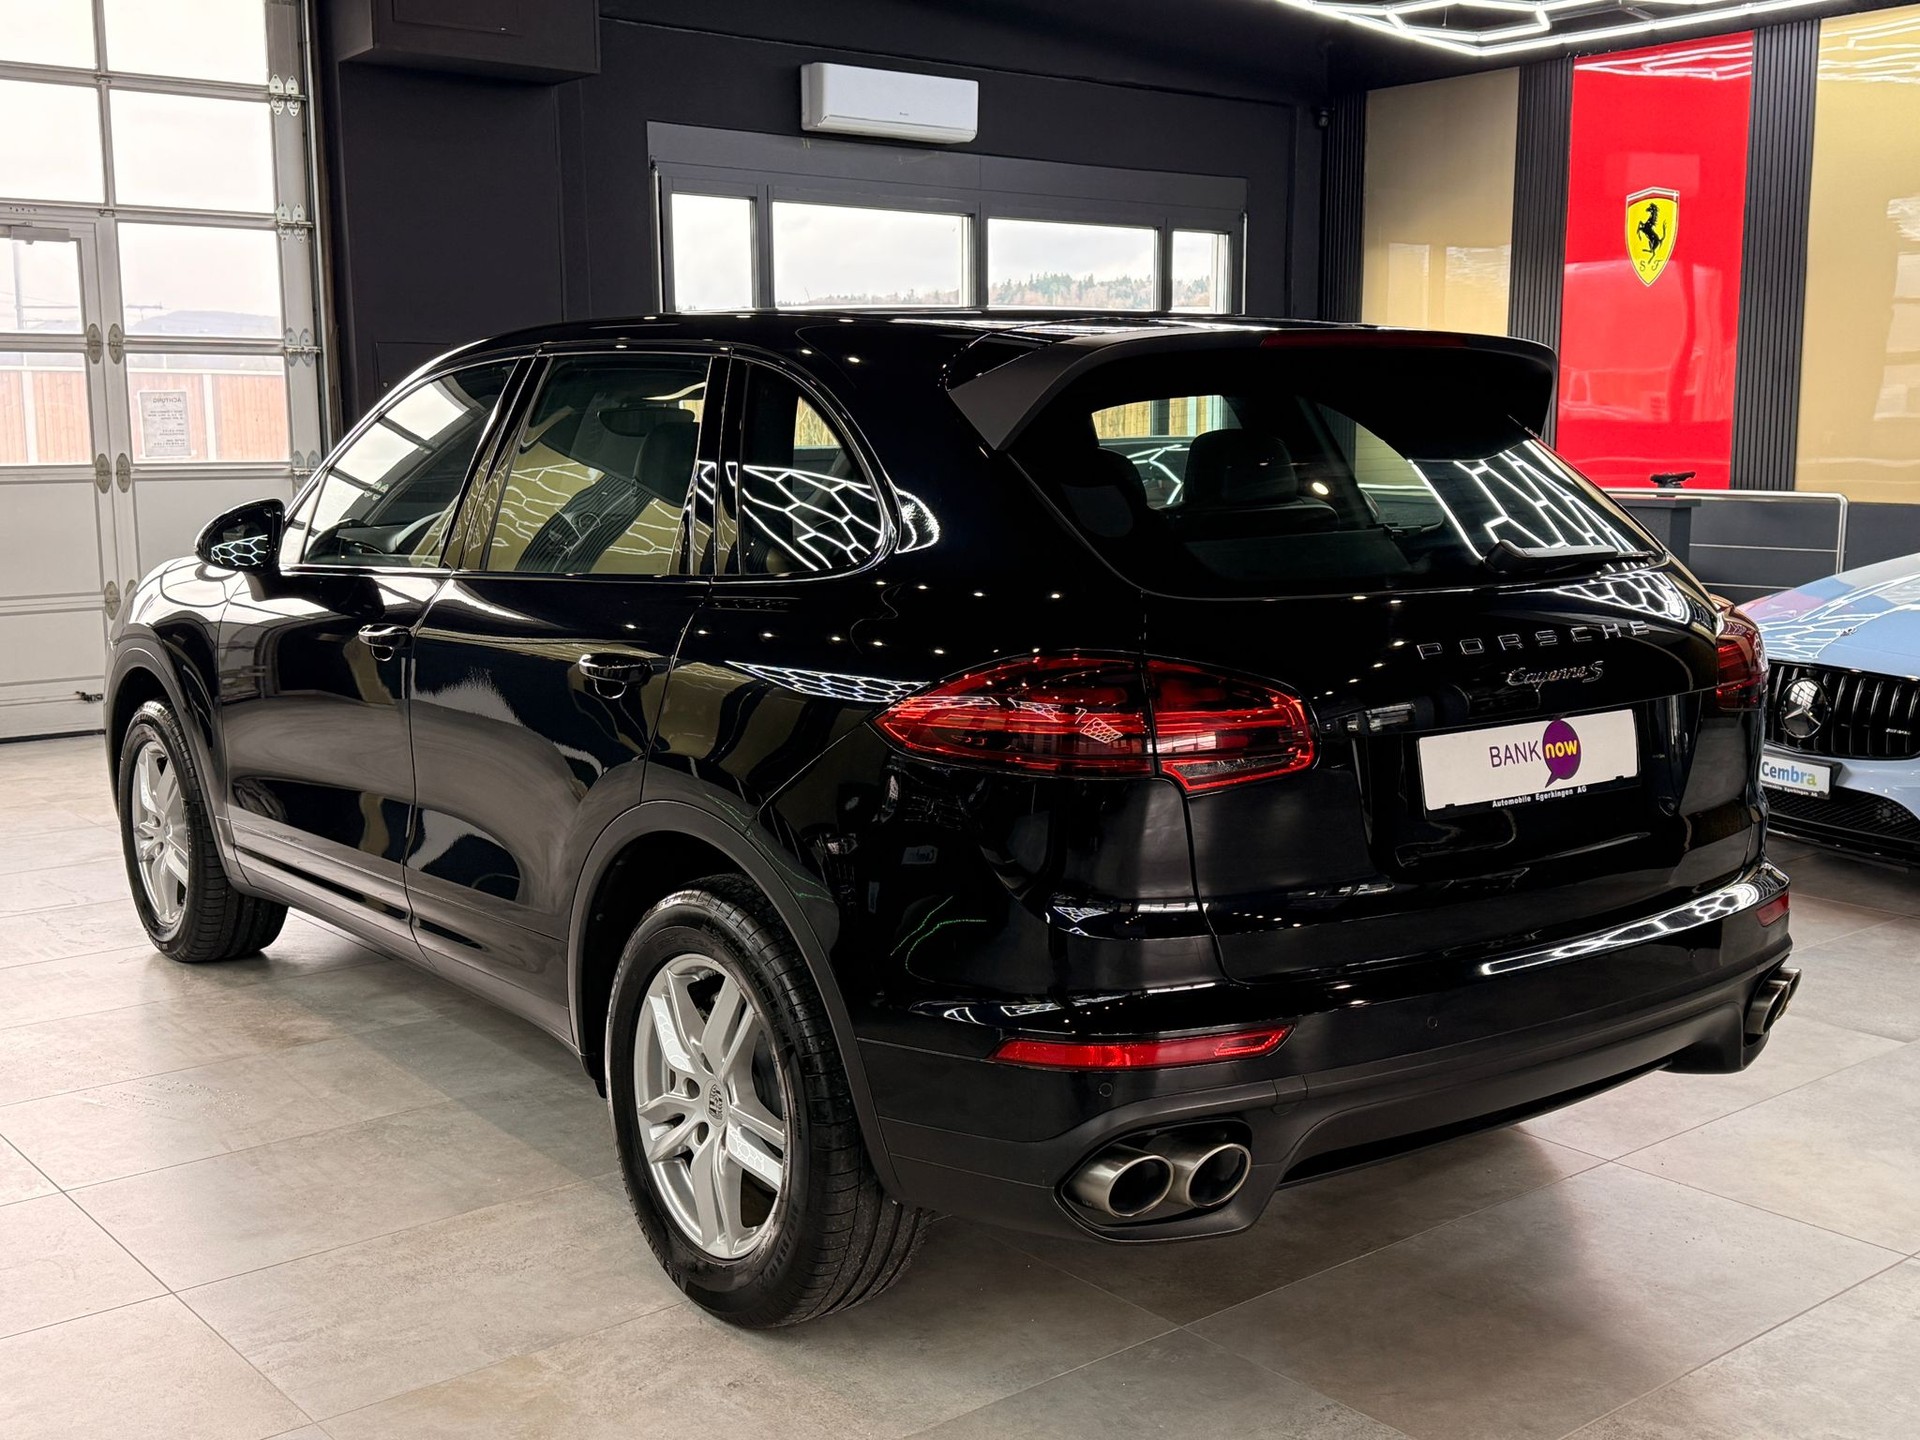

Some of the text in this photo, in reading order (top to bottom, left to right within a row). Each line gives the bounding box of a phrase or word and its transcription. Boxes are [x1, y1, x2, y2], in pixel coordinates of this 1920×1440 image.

[1416, 620, 1650, 660] PORSCHE
[1507, 660, 1604, 691] Cayenne S
[1489, 739, 1578, 768] BANK now
[1761, 761, 1817, 786] Cembra
[1492, 785, 1587, 808] Automobile Egerkingen AG
